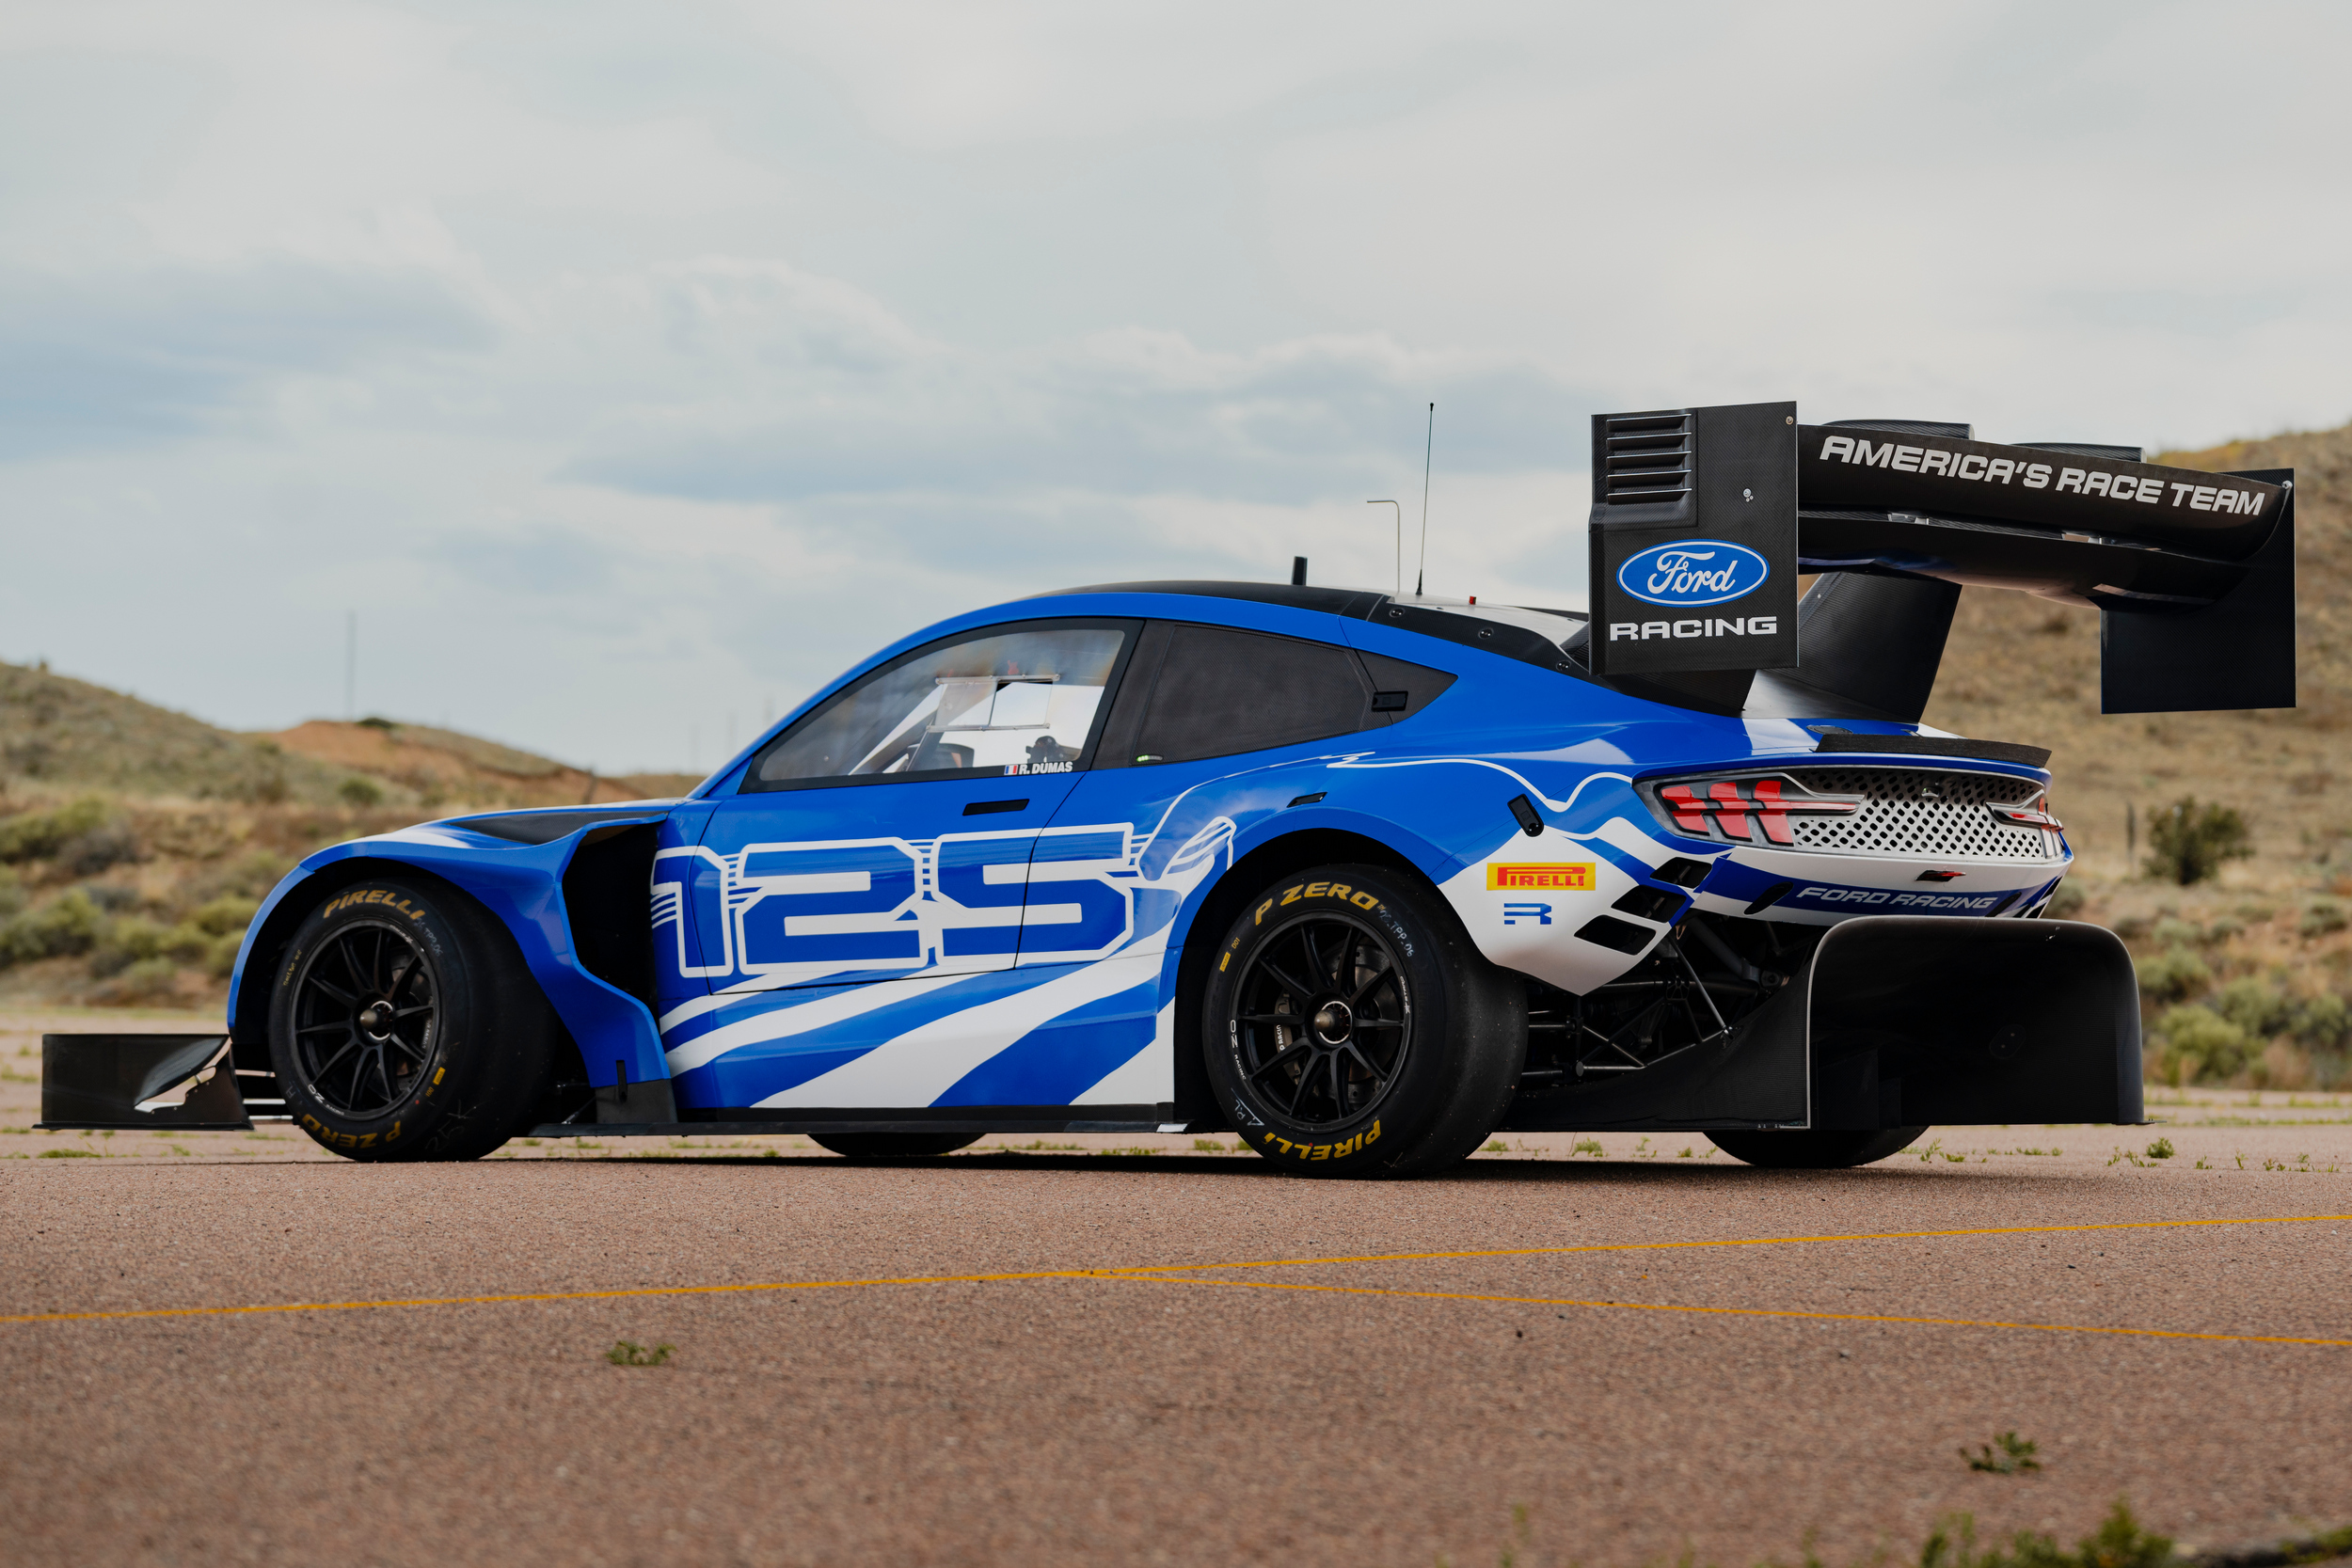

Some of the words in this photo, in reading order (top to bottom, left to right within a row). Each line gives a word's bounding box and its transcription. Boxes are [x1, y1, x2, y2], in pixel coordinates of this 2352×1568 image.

[1819, 435, 2053, 489] AMERICA'S
[2055, 467, 2165, 505] RACE
[2169, 482, 2265, 516] TEAM
[1647, 550, 1739, 594] Ford
[1610, 615, 1777, 641] RACING
[1018, 764, 1030, 775] R.
[1031, 761, 1073, 774] DUMAS
[1497, 866, 1586, 886] PIRELLI
[323, 889, 426, 920] PIRELLI
[1255, 897, 1273, 926] P
[1280, 881, 1379, 911] ZERO
[1796, 886, 1891, 904] FORD
[1888, 893, 1998, 909] RACING
[1276, 1023, 1284, 1044] RACIN
[302, 1114, 378, 1148] ZERO
[385, 1120, 401, 1143] P
[1262, 1119, 1381, 1161] PIRELLI
